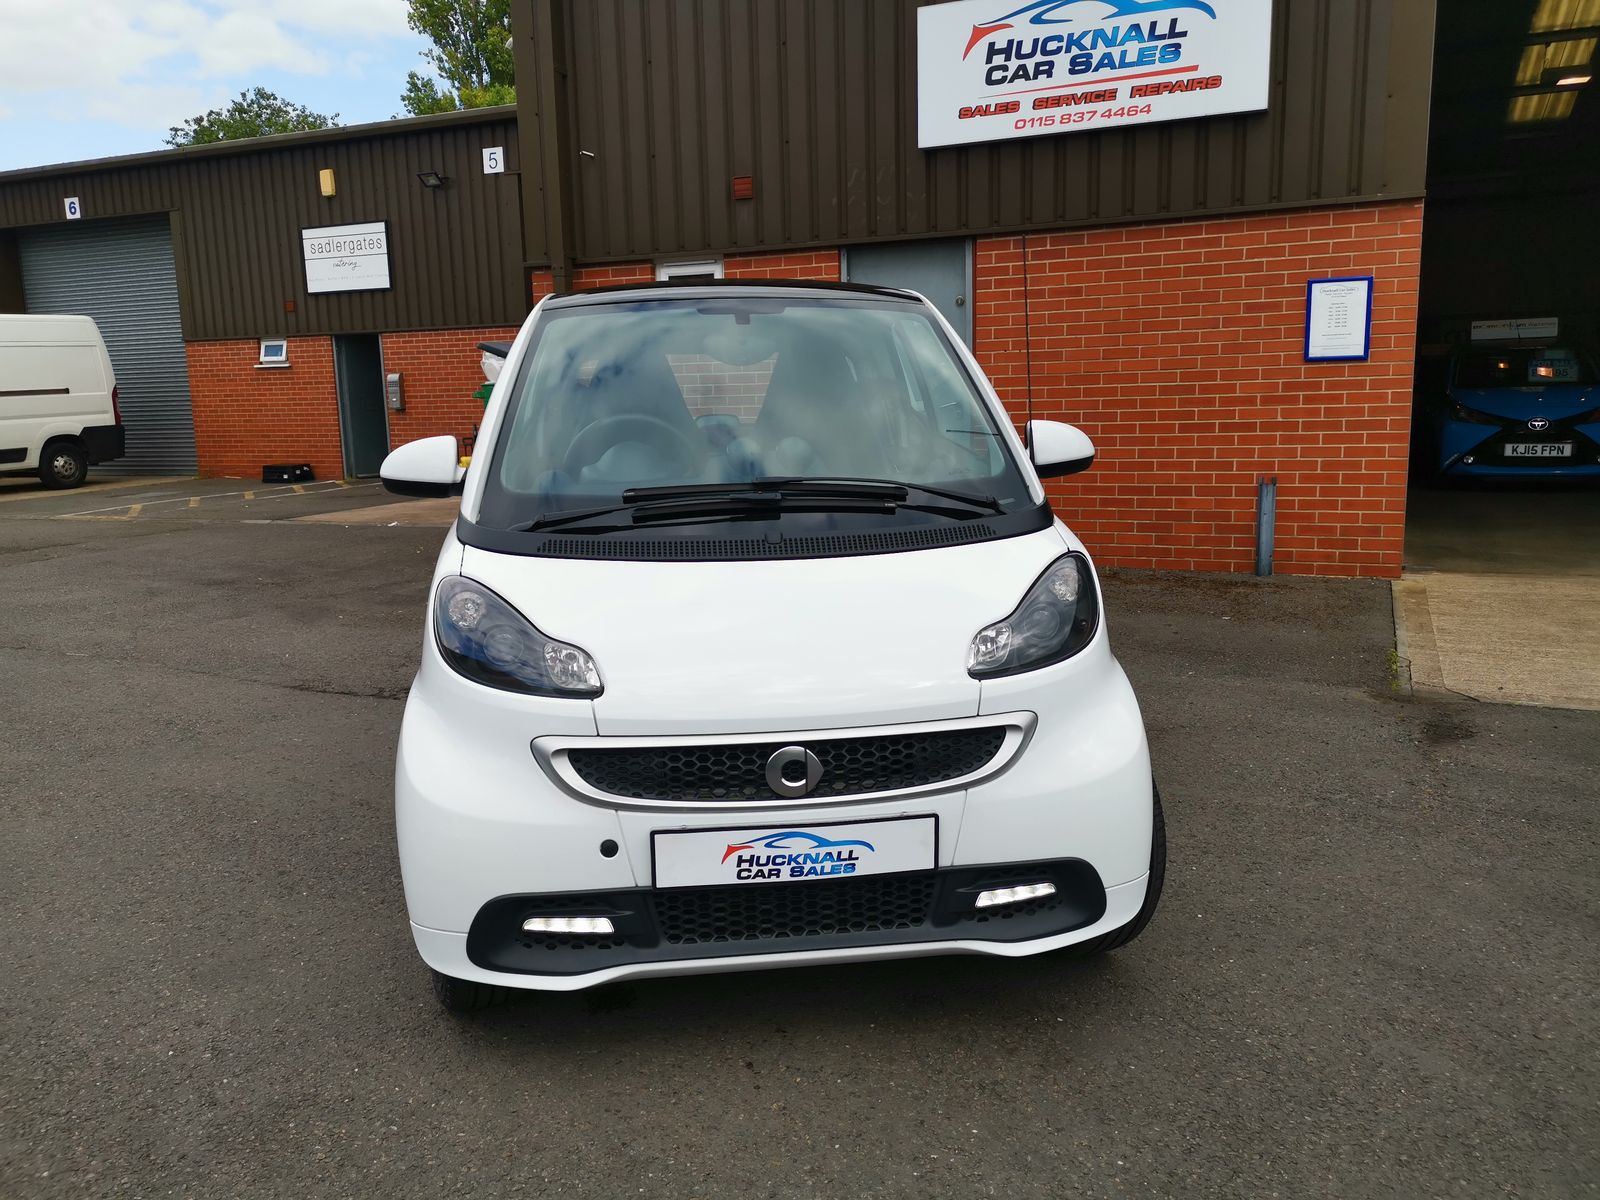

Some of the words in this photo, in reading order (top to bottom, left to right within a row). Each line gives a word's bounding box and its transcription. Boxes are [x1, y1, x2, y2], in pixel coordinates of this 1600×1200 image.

[985, 18, 1188, 65] HUCKNALL
[985, 60, 1055, 86] CAR
[1068, 43, 1183, 76] SALES
[959, 100, 1020, 119] SALES
[1032, 88, 1117, 111] SERVICE
[1130, 75, 1222, 99] REPAIRS
[1014, 115, 1055, 130] 0115
[1060, 110, 1096, 126] 837
[1100, 104, 1152, 120] 4464
[488, 151, 498, 169] 5
[68, 201, 77, 215] 6
[310, 237, 382, 254] sadlergates
[1511, 445, 1538, 455] KJ15
[1541, 445, 1565, 455] FPN
[736, 850, 860, 868] HUCKNALL
[736, 868, 781, 881] CAR
[789, 862, 857, 878] SALES
